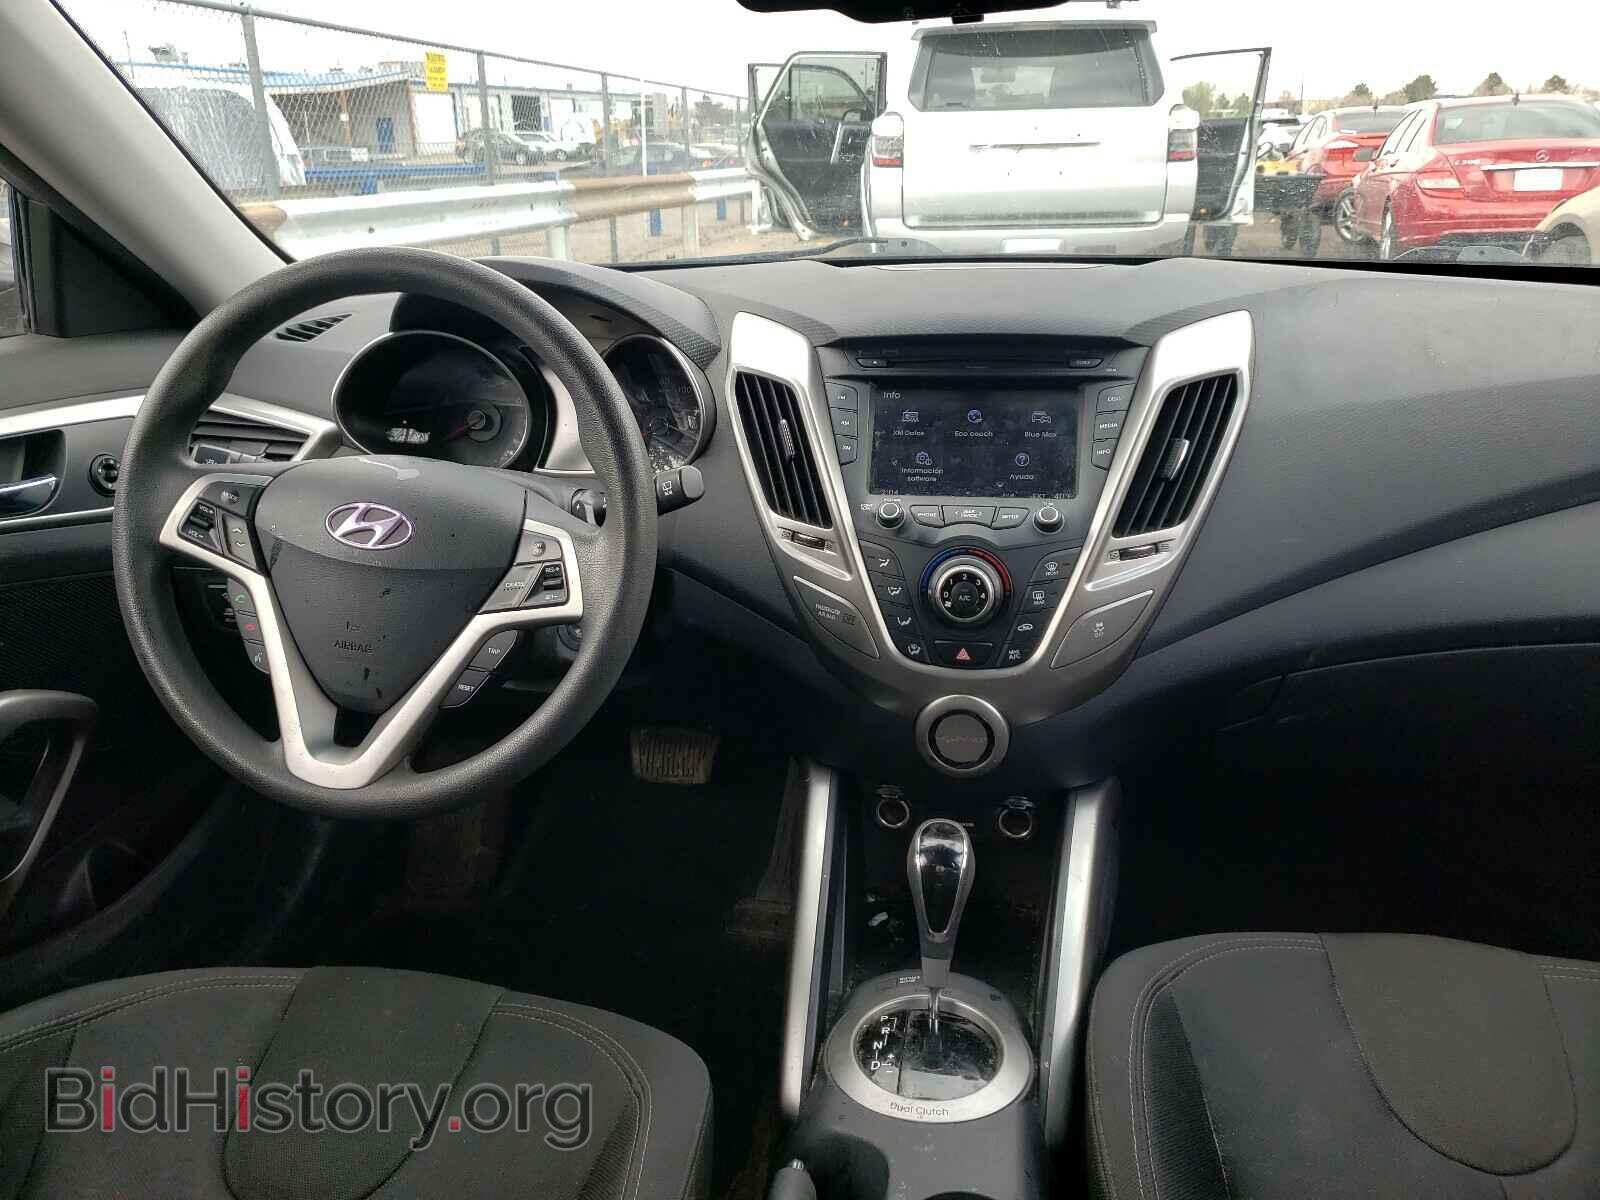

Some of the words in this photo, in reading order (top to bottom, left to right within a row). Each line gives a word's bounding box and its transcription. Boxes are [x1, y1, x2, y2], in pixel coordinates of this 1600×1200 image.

[883, 391, 901, 399] Info
[881, 1026, 890, 1034] R
[873, 1041, 882, 1050] N
[870, 1060, 880, 1070] D
[890, 1101, 913, 1113] Dual
